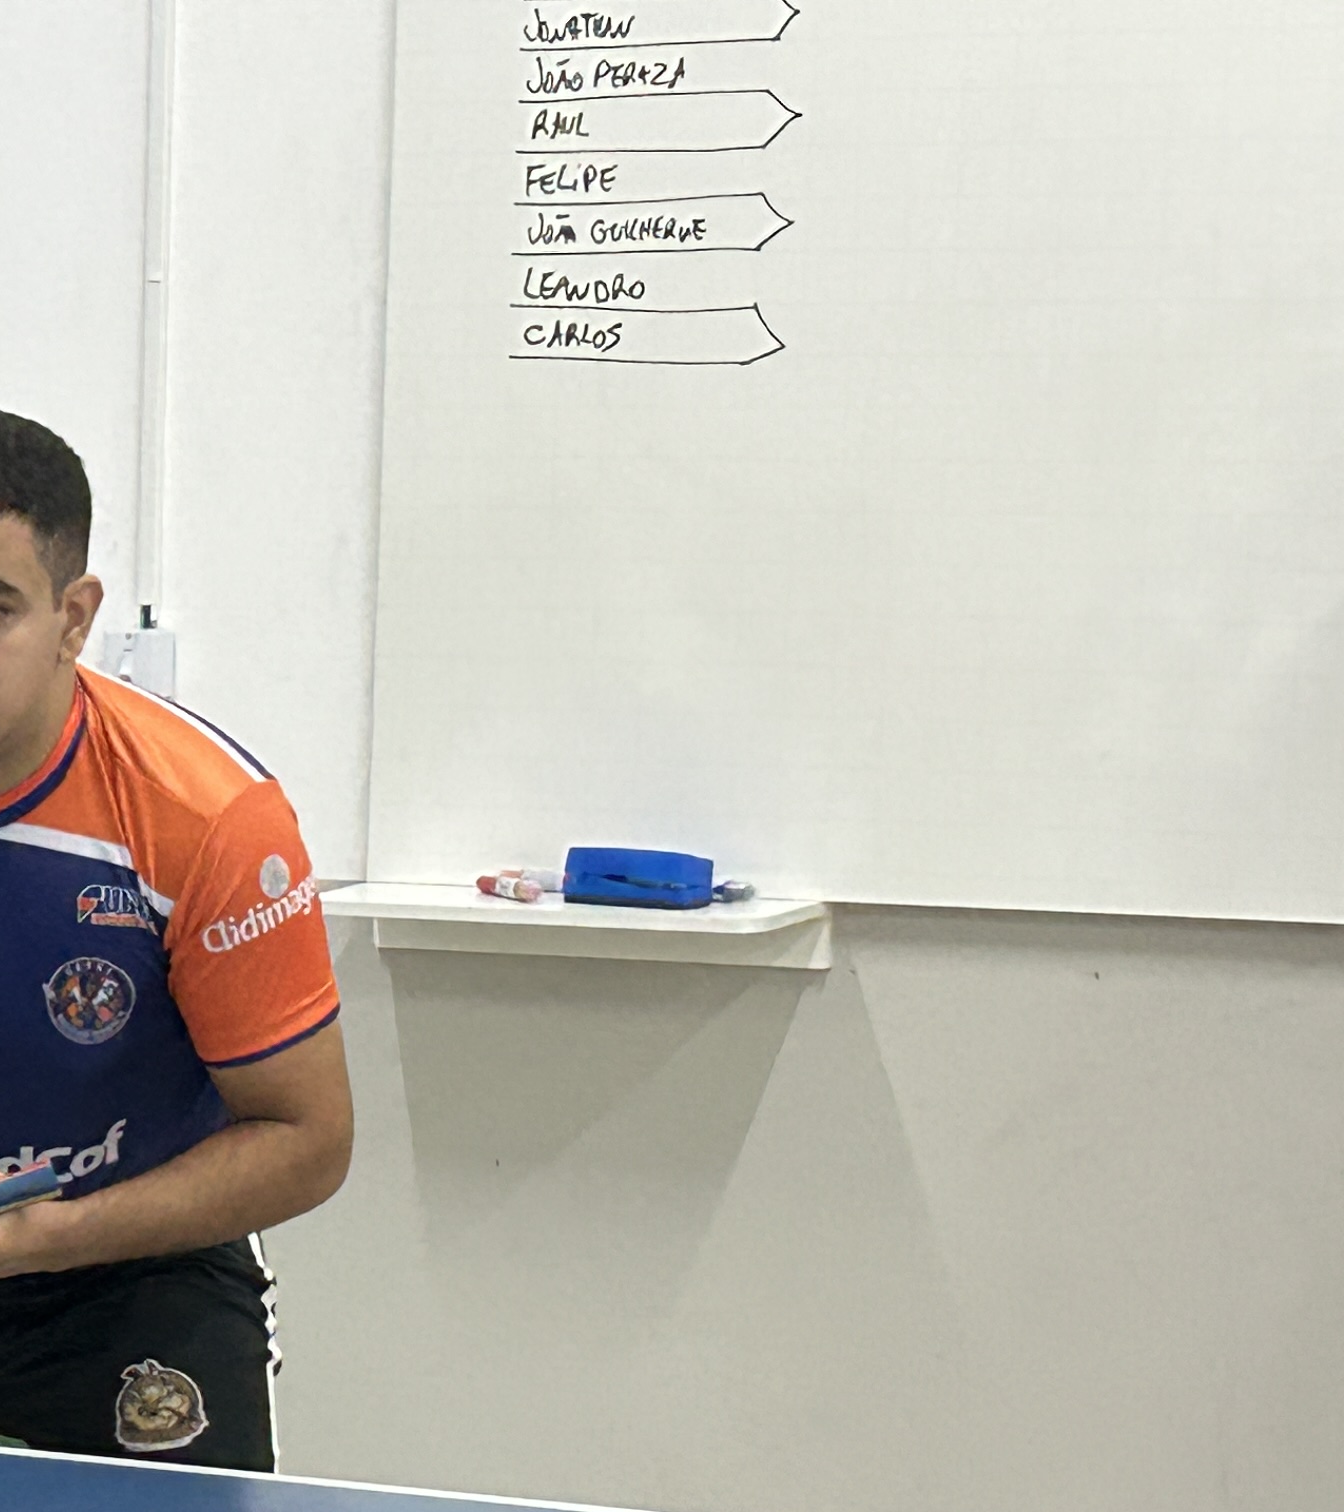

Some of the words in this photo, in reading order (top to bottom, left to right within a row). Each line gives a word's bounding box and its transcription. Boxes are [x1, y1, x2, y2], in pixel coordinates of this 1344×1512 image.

[526, 56, 584, 94] JOÃO
[531, 108, 590, 140] RAUL
[523, 267, 646, 304] LEANDRO
[523, 319, 623, 353] CARLOS
